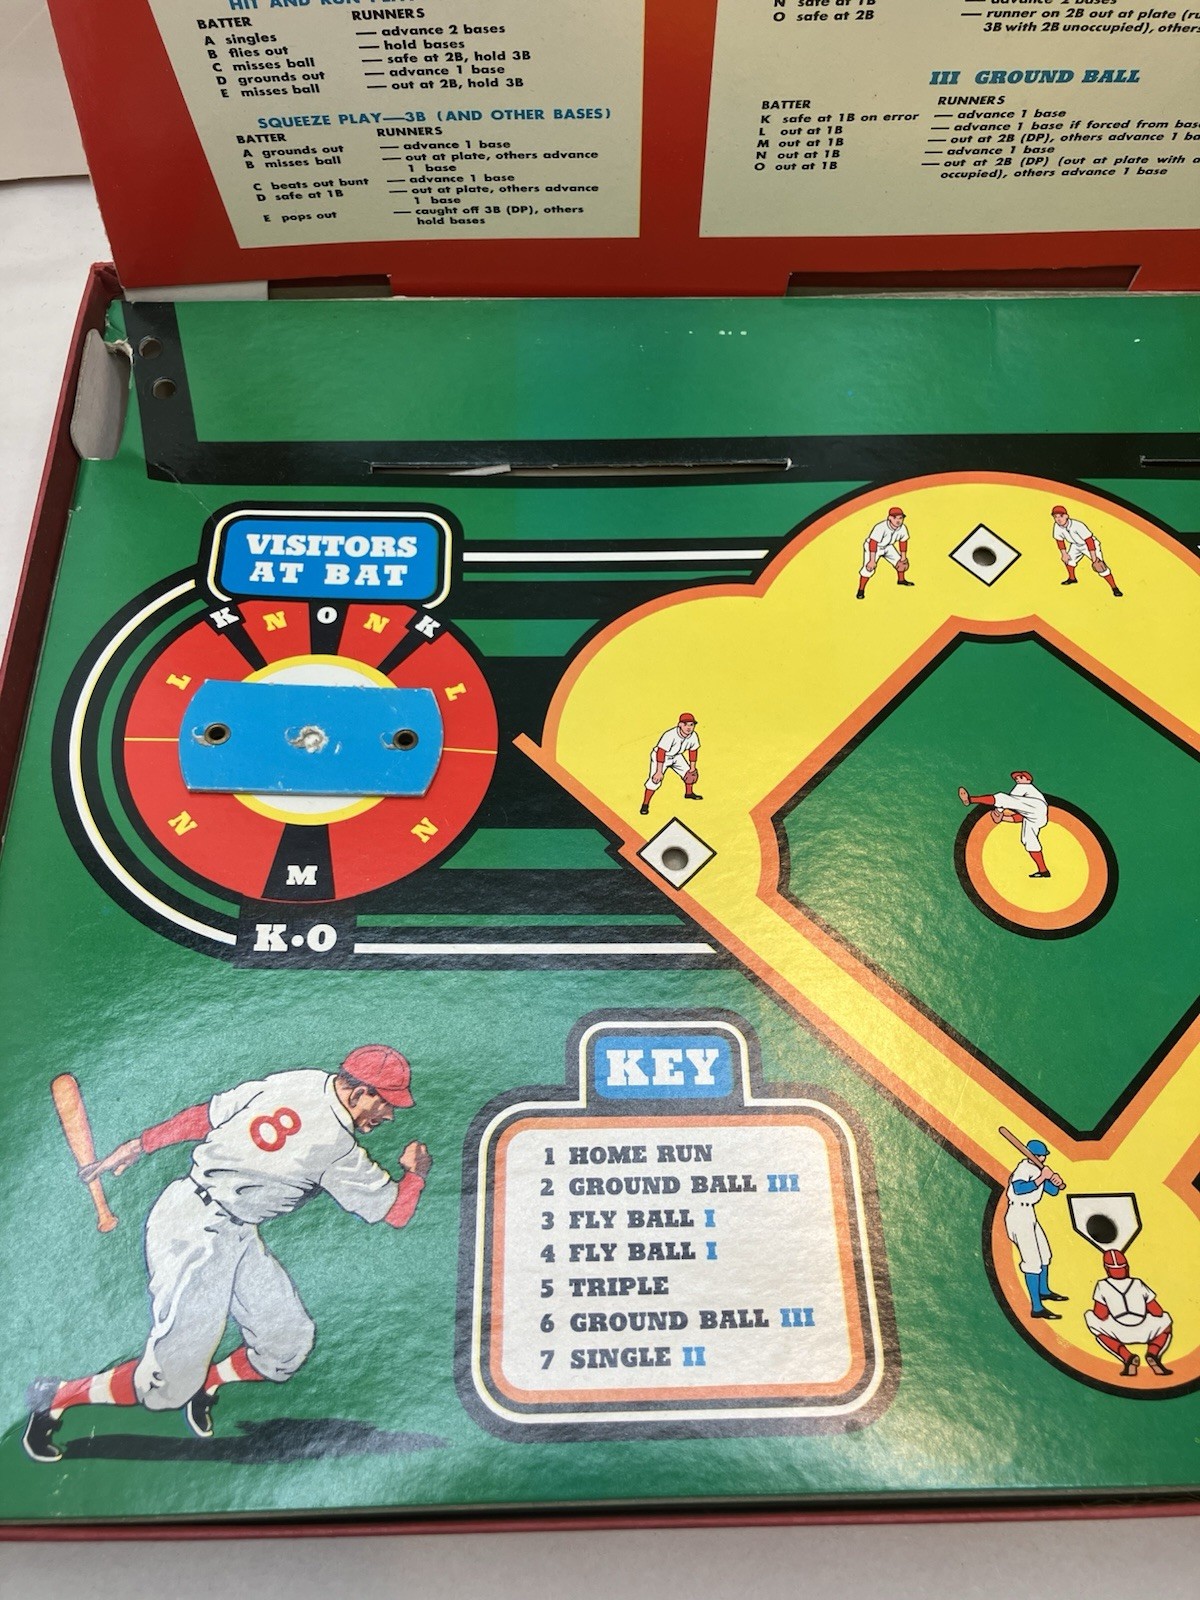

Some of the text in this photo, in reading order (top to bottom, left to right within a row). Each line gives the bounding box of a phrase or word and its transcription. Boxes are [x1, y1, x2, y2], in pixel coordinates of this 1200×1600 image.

[229, 0, 258, 10] HIT
[270, 0, 310, 8] AND
[352, 8, 425, 20] RUNNERS
[774, 10, 874, 21] O safe at 2B
[987, 8, 1176, 20] runner on 2B out at plate
[197, 17, 252, 29] BATTER
[983, 22, 1200, 34] 3B with 2B unoccupied), others
[382, 24, 505, 36] advance 2 bases
[205, 33, 277, 45] A singles
[384, 39, 464, 50] hold bases
[207, 46, 288, 59] B flies out
[388, 51, 530, 63] safe at 2B, hold 3B
[213, 58, 315, 72] C misses ball
[390, 65, 504, 76] advance 1 base
[216, 71, 324, 86] D grounds out
[929, 70, 1140, 84] III GROUND BALL
[392, 78, 523, 90] out at 2B, hold 3B
[221, 84, 320, 98] E misses ball
[762, 100, 810, 109] BATTER
[938, 96, 1005, 105] RUNNERS
[258, 115, 331, 128] SQUEEZE
[491, 110, 545, 120] OTHER
[761, 112, 919, 124] K safe at 1B on error
[377, 127, 442, 136] RUNNERS
[759, 125, 842, 136] L out at 1B
[236, 134, 286, 143] BATTER
[404, 139, 510, 151] advance 1 base
[243, 145, 343, 159] A grounds out
[406, 150, 598, 162] out at plate, others advance
[245, 156, 341, 169] B misses ball
[755, 161, 837, 171] O out at 1B
[941, 166, 1167, 179] occupied), others advance 1 base
[253, 178, 368, 191] C beats out bunt
[263, 211, 336, 223] E pops out
[416, 205, 583, 216] caught off 3B (DP), others
[417, 216, 485, 226] hold bases
[247, 533, 418, 560] VISITORS
[250, 562, 408, 587] AT BAT
[210, 607, 239, 630] K
[263, 610, 287, 631] N
[316, 606, 338, 624] O
[363, 611, 389, 635] N
[414, 615, 441, 638] K
[165, 674, 192, 691] L
[444, 682, 467, 701] L
[169, 811, 197, 836] N
[411, 817, 439, 843] N
[286, 865, 318, 885] M
[605, 1047, 721, 1088] KEY
[249, 1107, 302, 1153] 8
[543, 1143, 714, 1166] 1 HOME RUN
[539, 1173, 800, 1197] 2 GROUND BALL III
[539, 1208, 716, 1231] 3 FLY BALL I
[539, 1240, 718, 1264] 4 FLY BALL I
[539, 1275, 670, 1299] 5 TRIPLE
[539, 1306, 816, 1334] 6 GROUND BALL III
[539, 1345, 707, 1371] 7 SINGLE II
